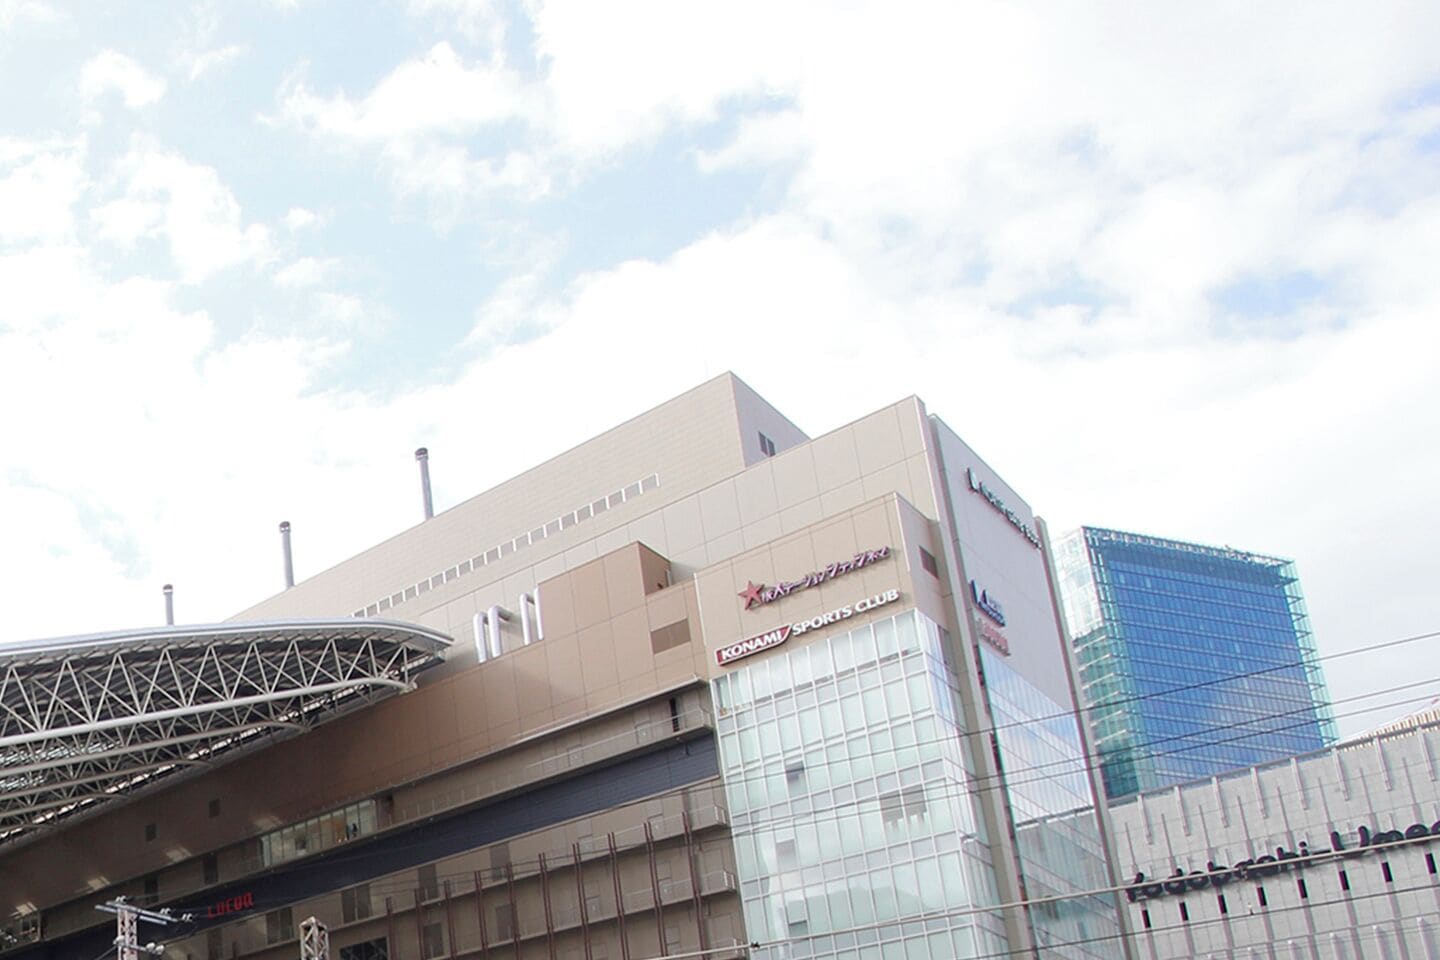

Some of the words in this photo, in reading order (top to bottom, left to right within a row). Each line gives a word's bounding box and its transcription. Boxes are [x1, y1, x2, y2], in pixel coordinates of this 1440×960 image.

[720, 630, 783, 660] KONAMI
[791, 605, 853, 636] SPORTS
[855, 588, 899, 613] CLUB
